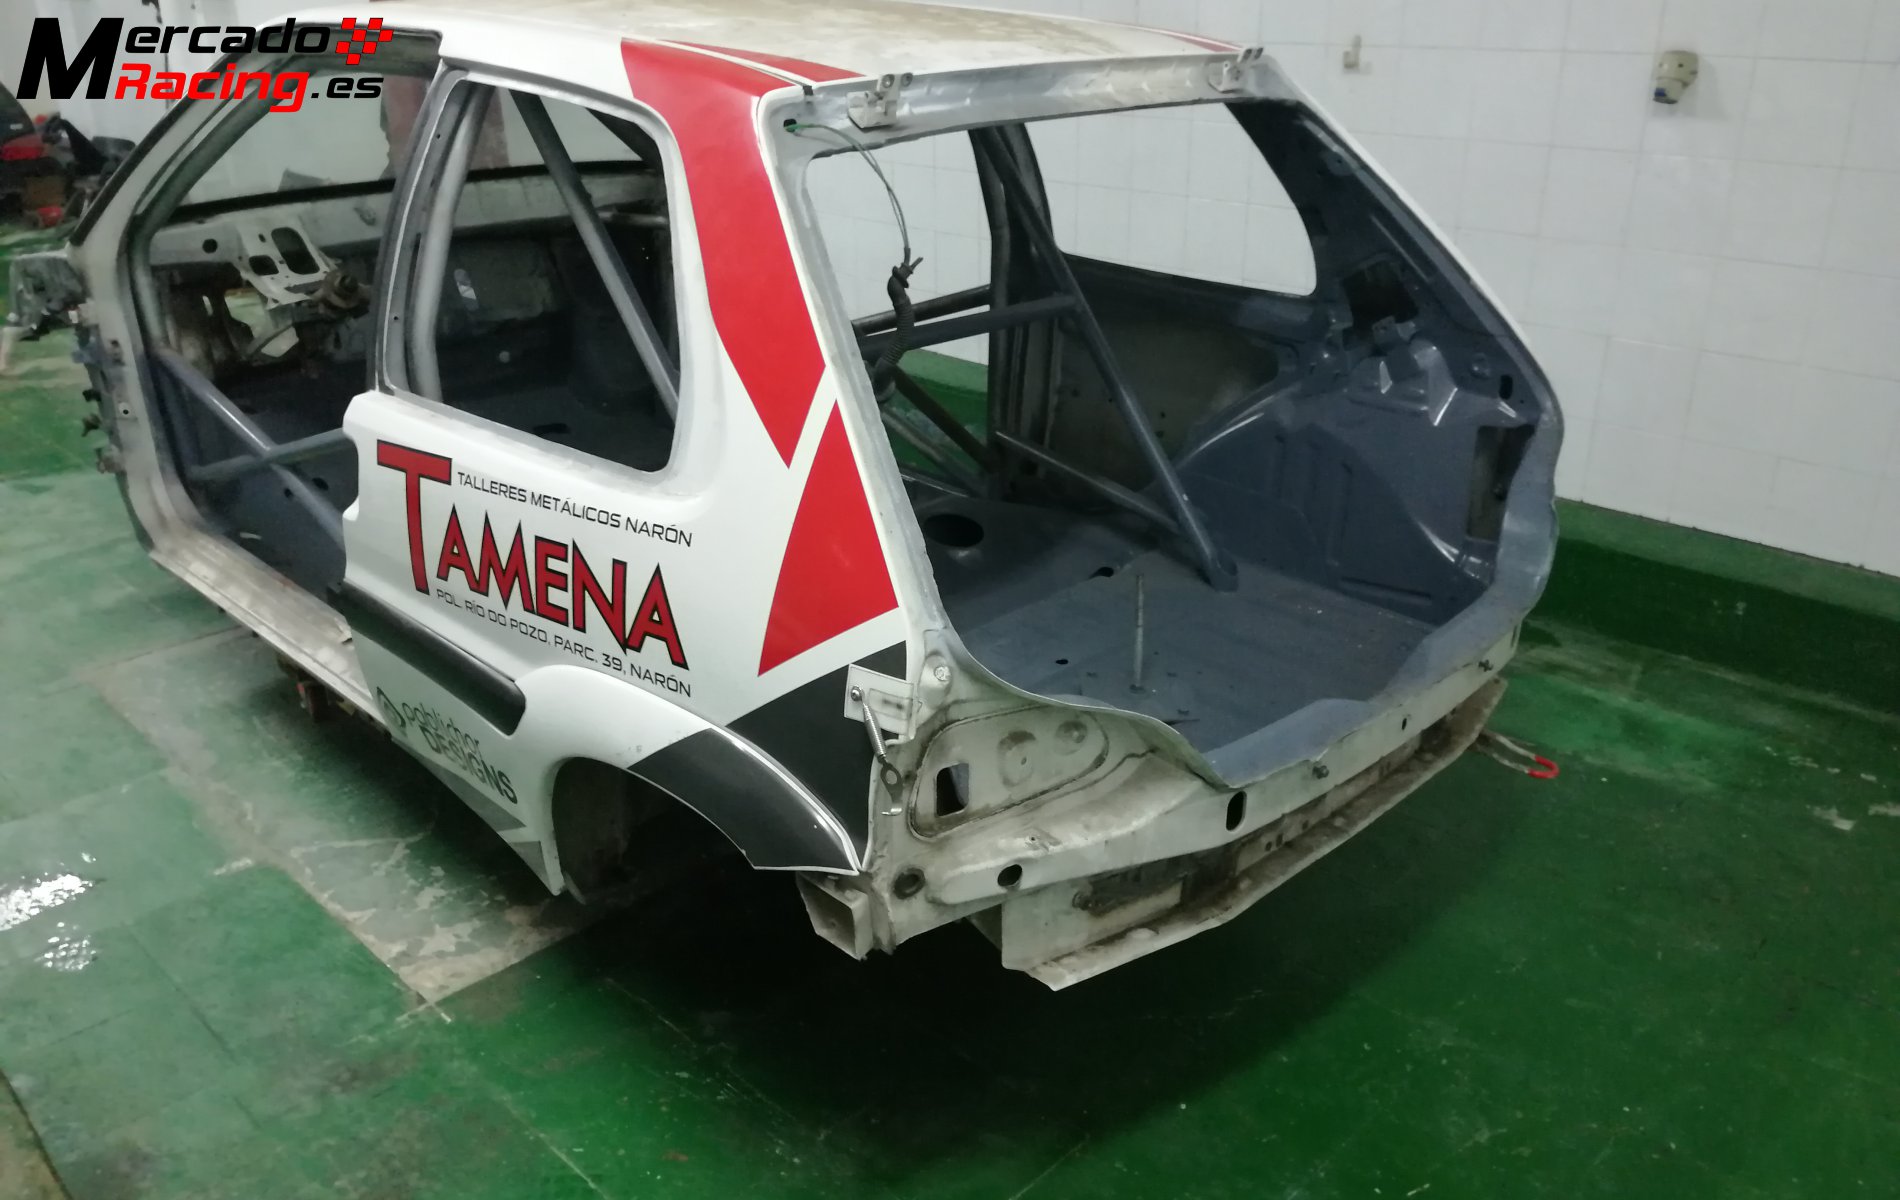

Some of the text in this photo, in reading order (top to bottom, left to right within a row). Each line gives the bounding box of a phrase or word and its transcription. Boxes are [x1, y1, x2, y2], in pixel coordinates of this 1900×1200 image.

[457, 471, 692, 547] TALLERES METÁLICOS NARÓN
[376, 438, 690, 671] TAMENA
[464, 599, 485, 618] RÍO
[554, 633, 598, 664] PARC.
[601, 652, 627, 676] 39,
[630, 662, 691, 698] NARÓN
[418, 723, 518, 804] DESIGNS
